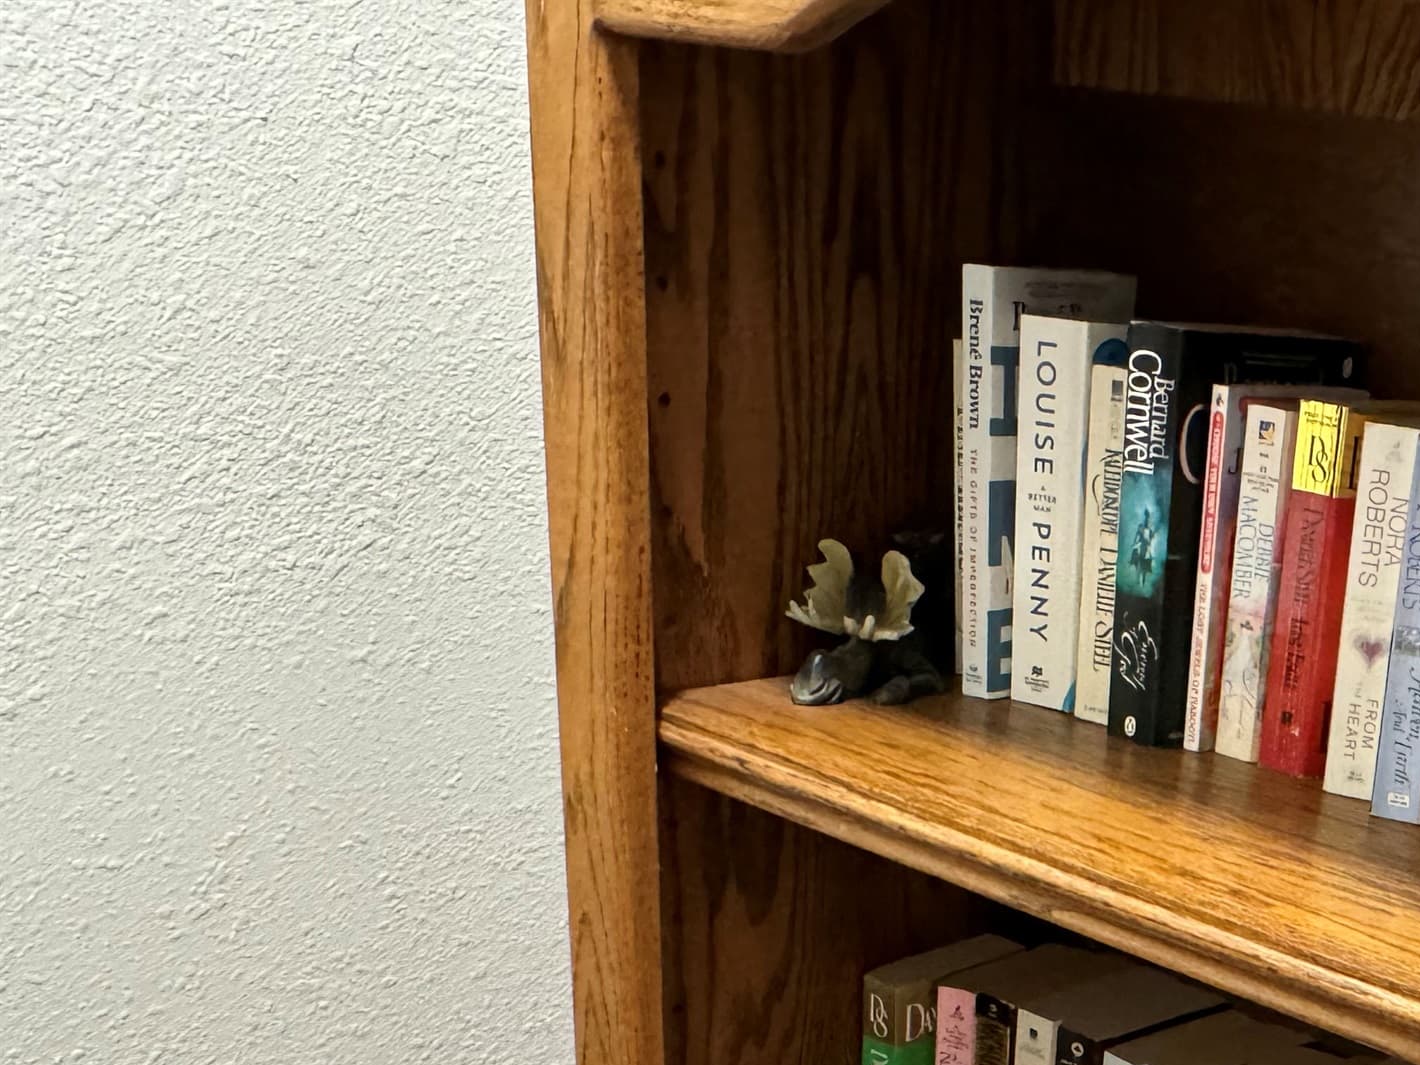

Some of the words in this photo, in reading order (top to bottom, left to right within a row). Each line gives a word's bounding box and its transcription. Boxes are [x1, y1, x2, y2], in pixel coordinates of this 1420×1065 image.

[967, 299, 983, 362] Brené
[966, 365, 982, 430] Brown
[1033, 340, 1057, 475] LOUISE
[1124, 349, 1162, 475] Cornwell
[1149, 377, 1176, 459] Bernard
[968, 449, 978, 472] THE
[1092, 448, 1123, 537] KALEIDOSCOPE
[1233, 495, 1260, 599] MACOMBER
[1254, 523, 1275, 584] DEBBIE
[1359, 468, 1390, 589] ROBERTS
[1383, 496, 1408, 568] NORA
[1030, 521, 1052, 642] PENNY
[1095, 548, 1119, 616] DANIELLE
[1093, 621, 1117, 673] STEEL
[1112, 631, 1139, 689] God
[1132, 620, 1158, 690] Enemy
[1343, 702, 1361, 762] HEART
[1360, 699, 1379, 751] FROM
